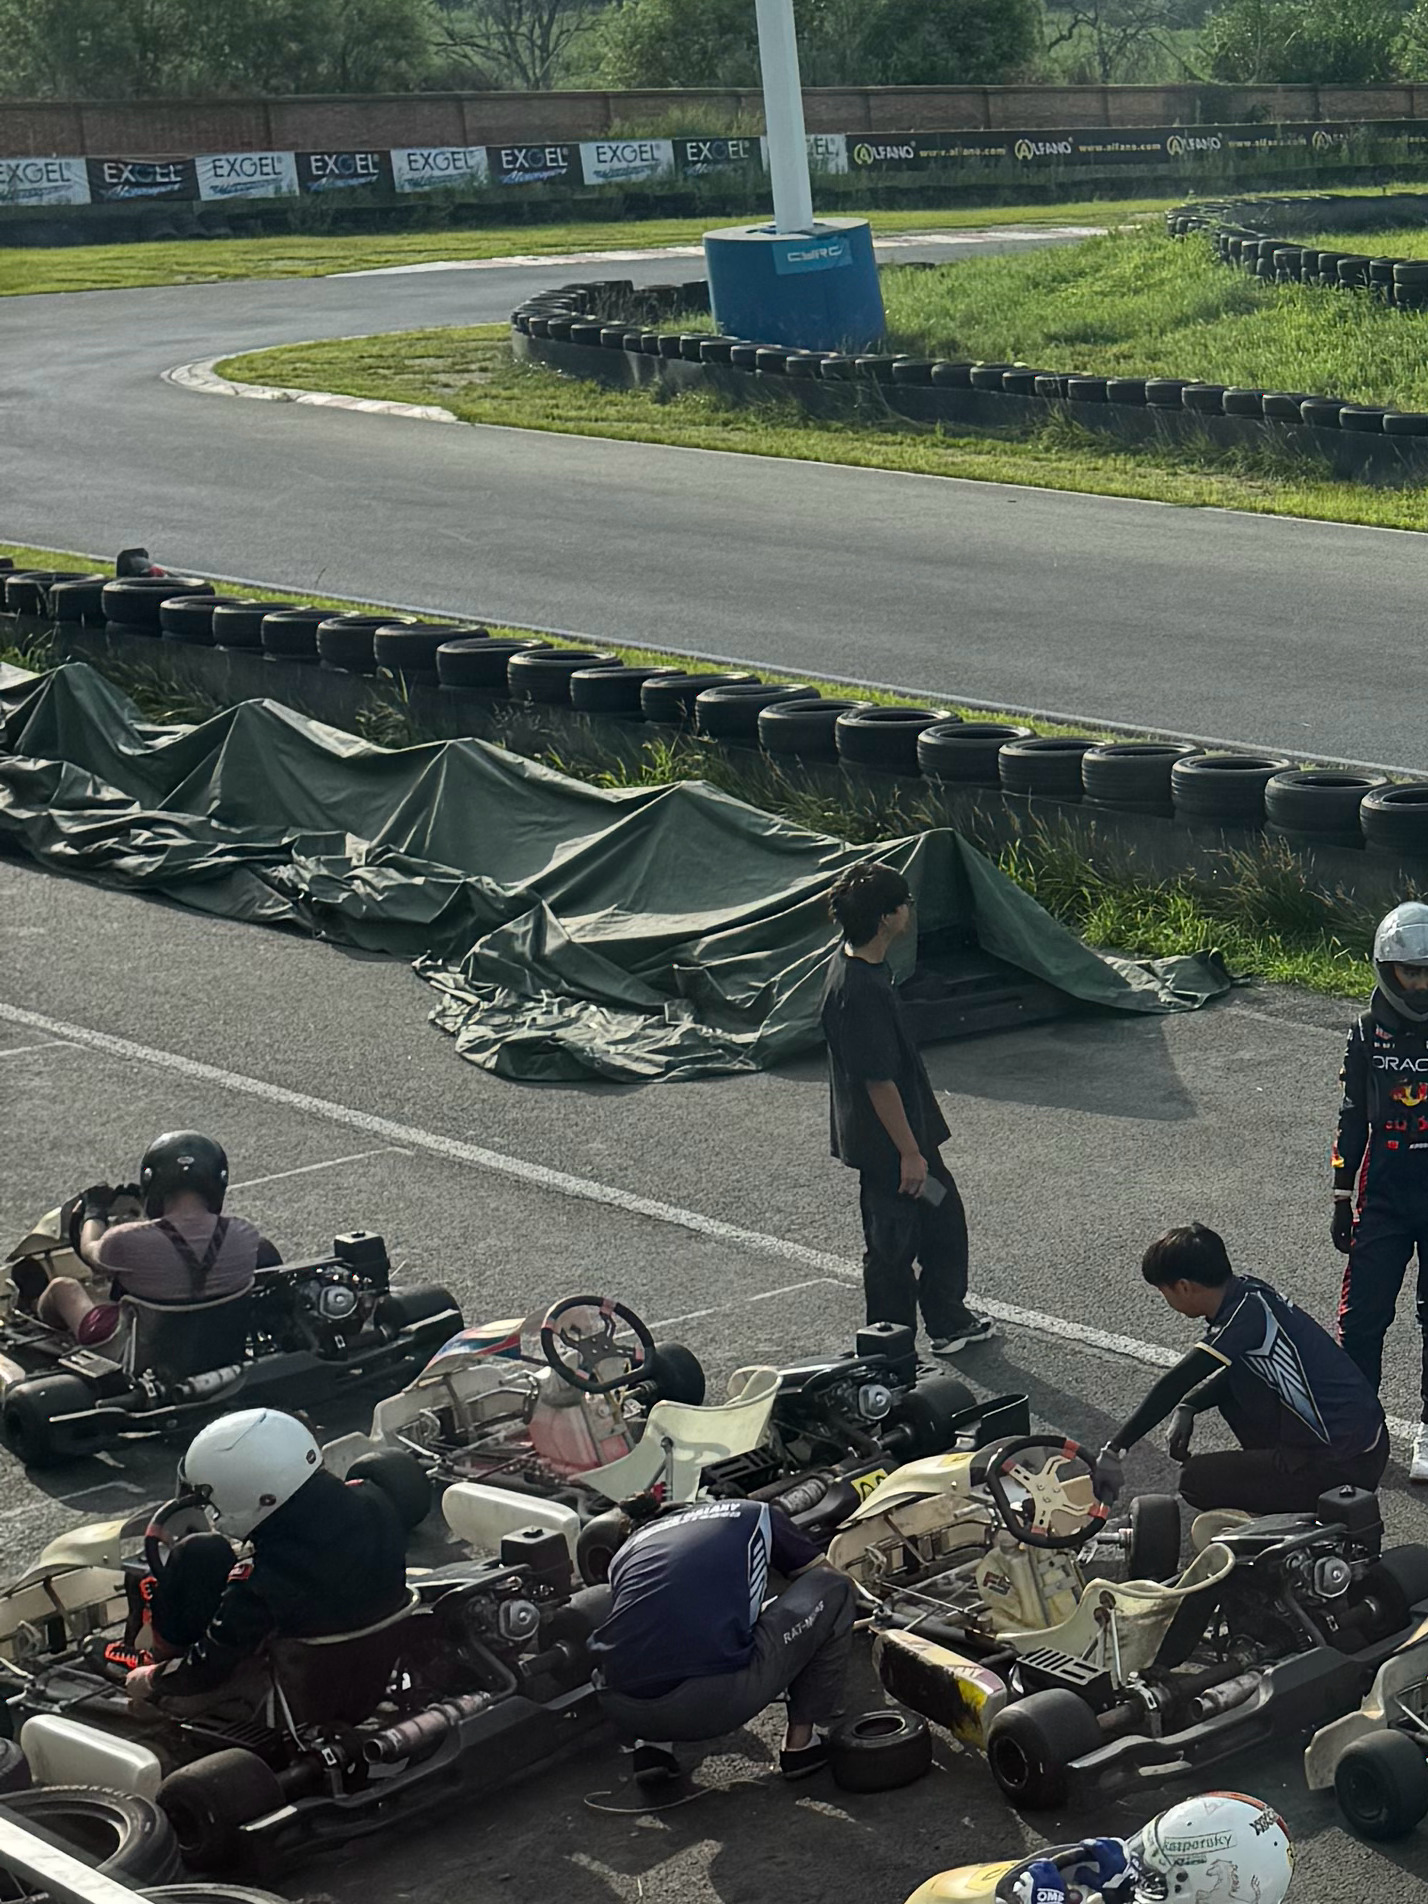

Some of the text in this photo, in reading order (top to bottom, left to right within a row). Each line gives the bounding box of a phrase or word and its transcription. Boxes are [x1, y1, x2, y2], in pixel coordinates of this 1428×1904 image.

[407, 150, 475, 172] EXGEL
[501, 148, 568, 169] EXGEL
[595, 143, 659, 164] EXGEL
[686, 140, 750, 161] EXGEL
[212, 155, 283, 177] EXGEL
[310, 153, 380, 175] EXGEL
